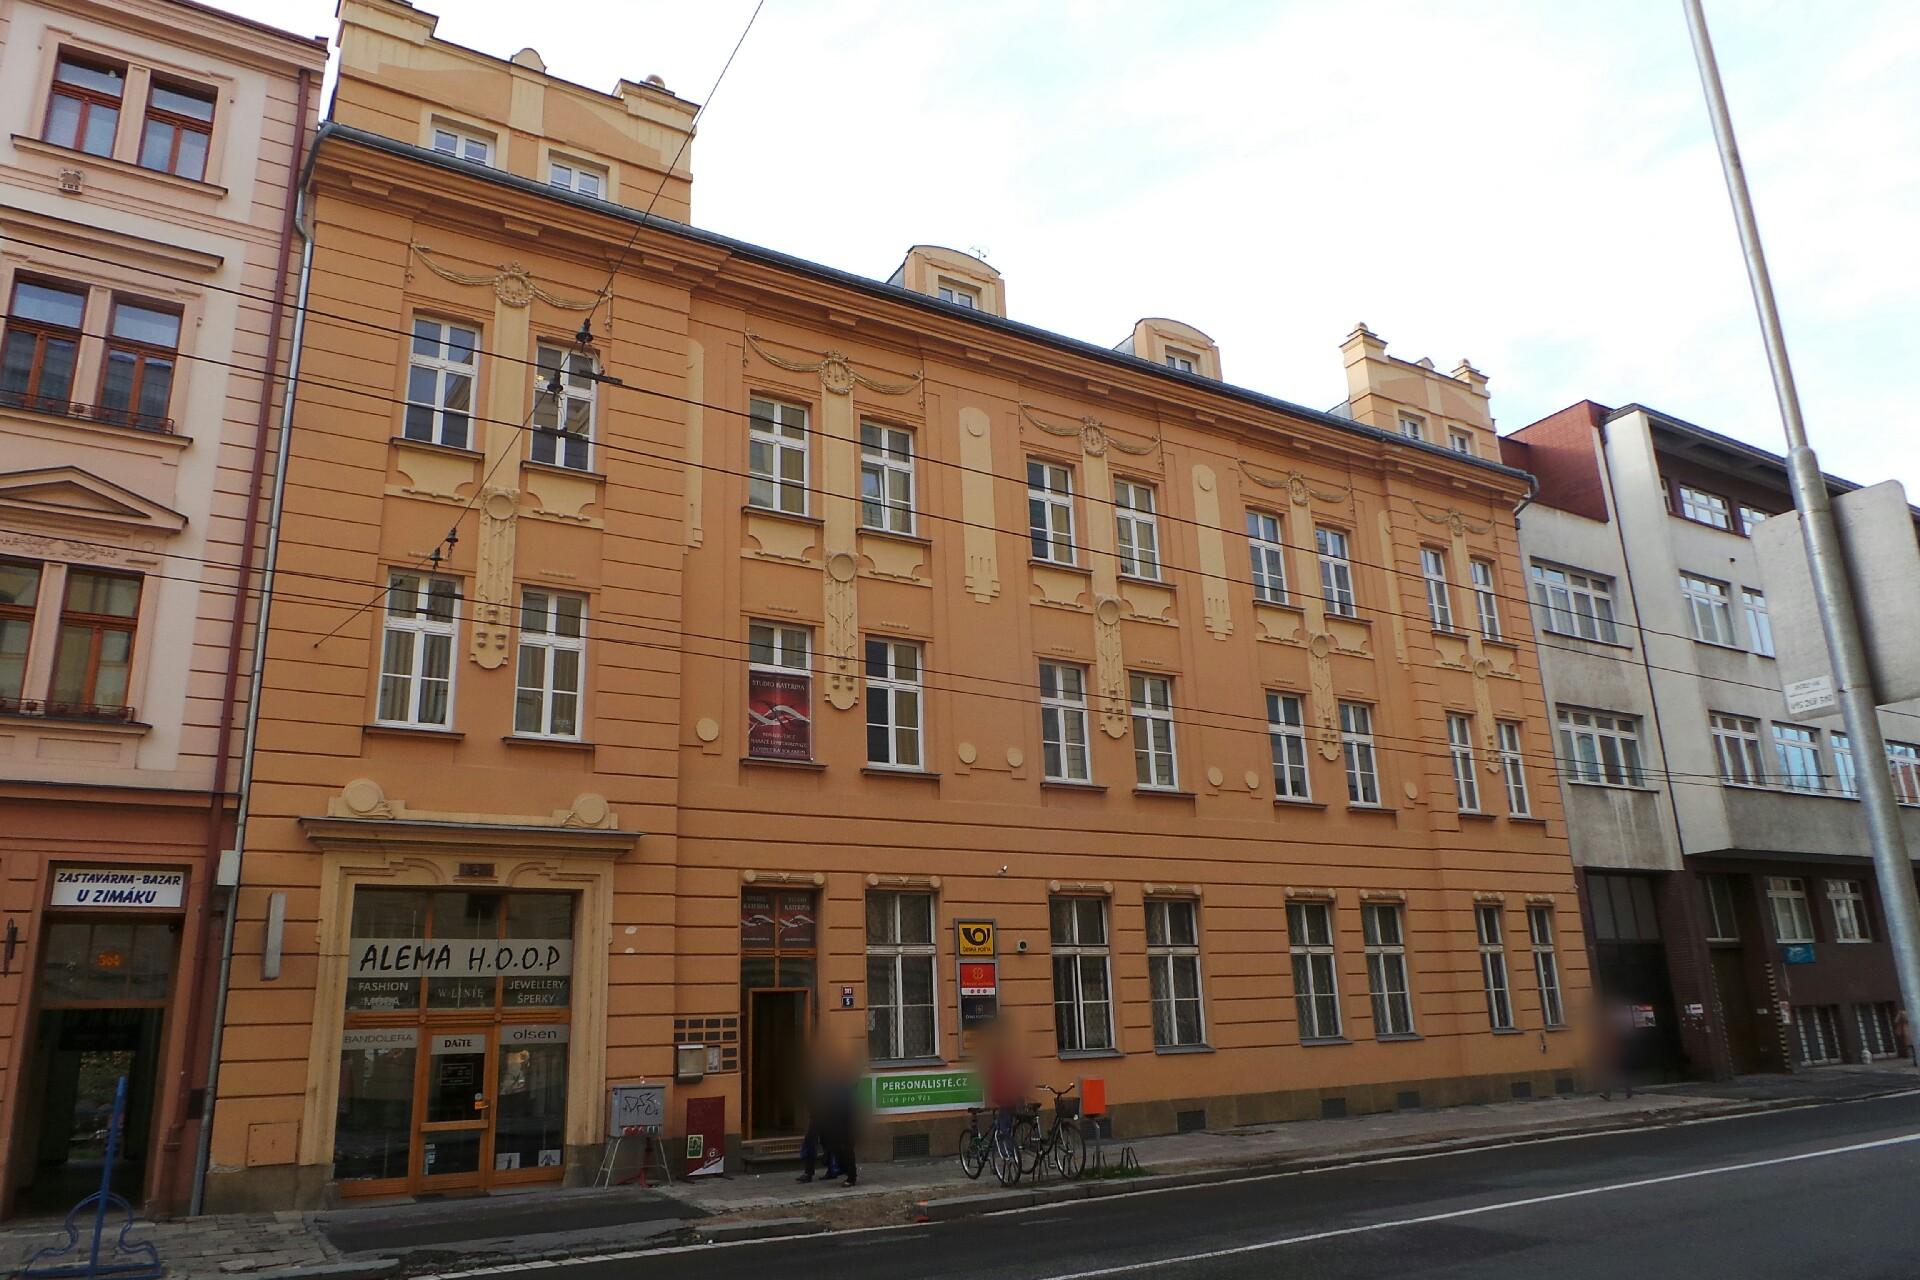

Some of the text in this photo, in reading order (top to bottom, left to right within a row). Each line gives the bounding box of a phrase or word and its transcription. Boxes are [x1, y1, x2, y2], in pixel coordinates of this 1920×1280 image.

[77, 886, 157, 904] U ZIMÁKU
[359, 944, 451, 972] ALEMA
[358, 982, 409, 992] FASHION
[508, 980, 565, 990] JEWELLERY
[517, 994, 555, 1004] ŠPERKY
[513, 1028, 557, 1041] olsen
[902, 1096, 915, 1104] pro
